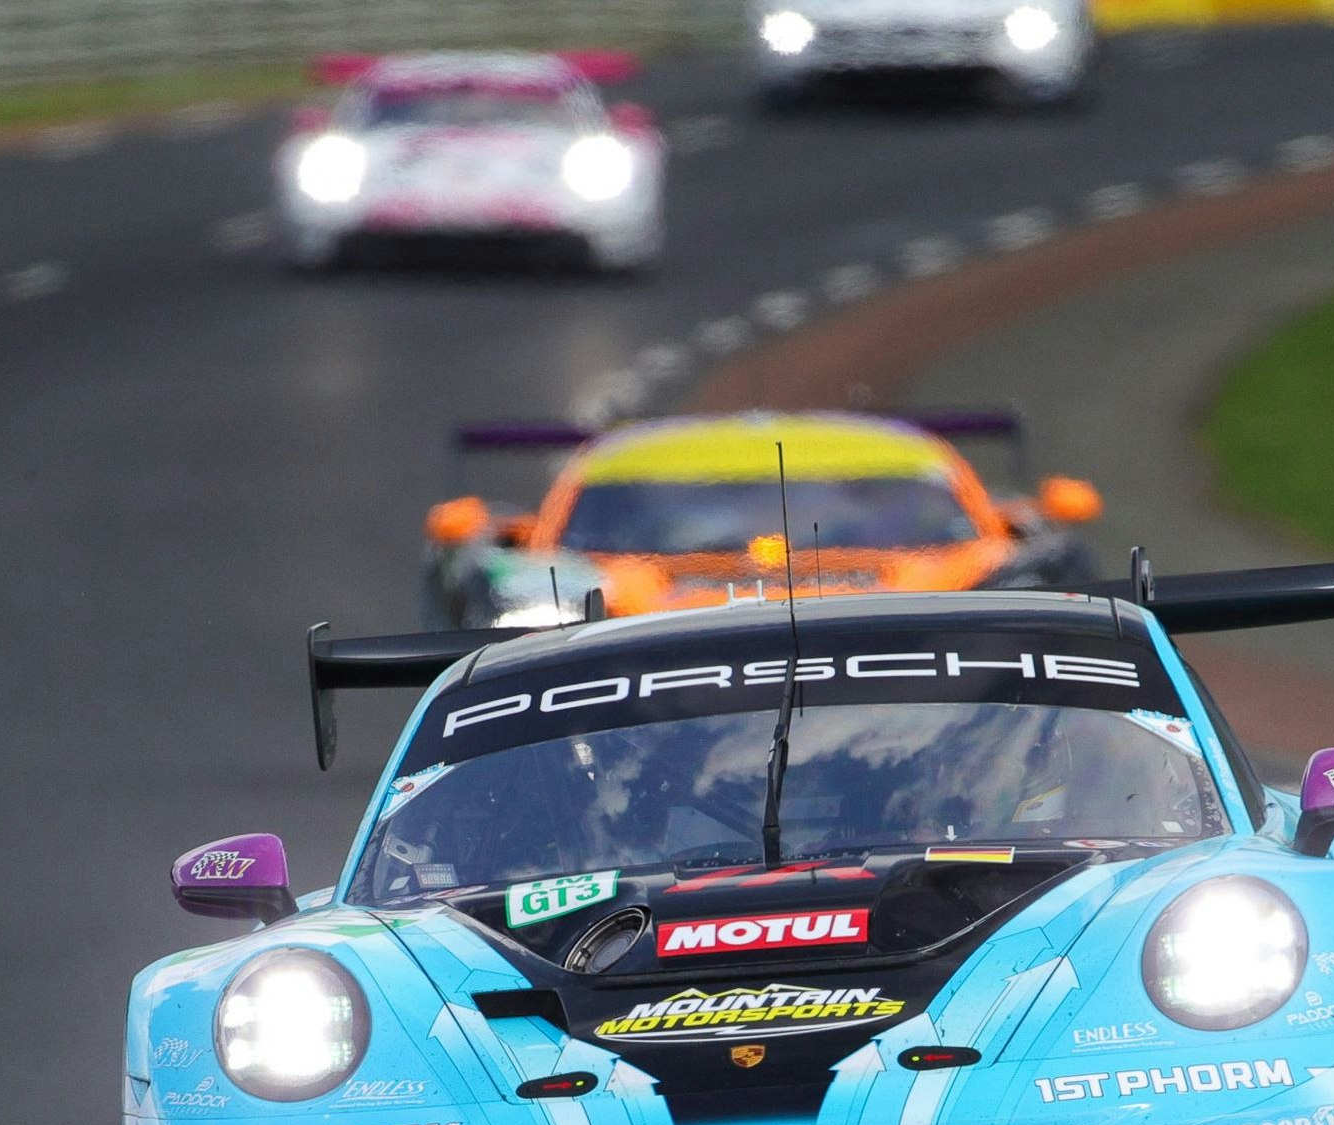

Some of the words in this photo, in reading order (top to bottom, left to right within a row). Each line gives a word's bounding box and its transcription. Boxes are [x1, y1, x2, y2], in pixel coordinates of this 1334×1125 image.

[443, 652, 1140, 737] PORSCHE
[196, 857, 255, 879] KW
[523, 883, 601, 915] GT3
[663, 913, 861, 951] MOTUL
[597, 1001, 906, 1035] MOTORSPORTS
[626, 988, 881, 1020] MOUNTAIN
[1074, 1020, 1158, 1044] ENDLESS
[341, 1080, 431, 1099] ENDLESS
[1035, 1072, 1111, 1103] 1ST
[1116, 1058, 1295, 1097] PHORM
[163, 1092, 232, 1108] PADDOCK
